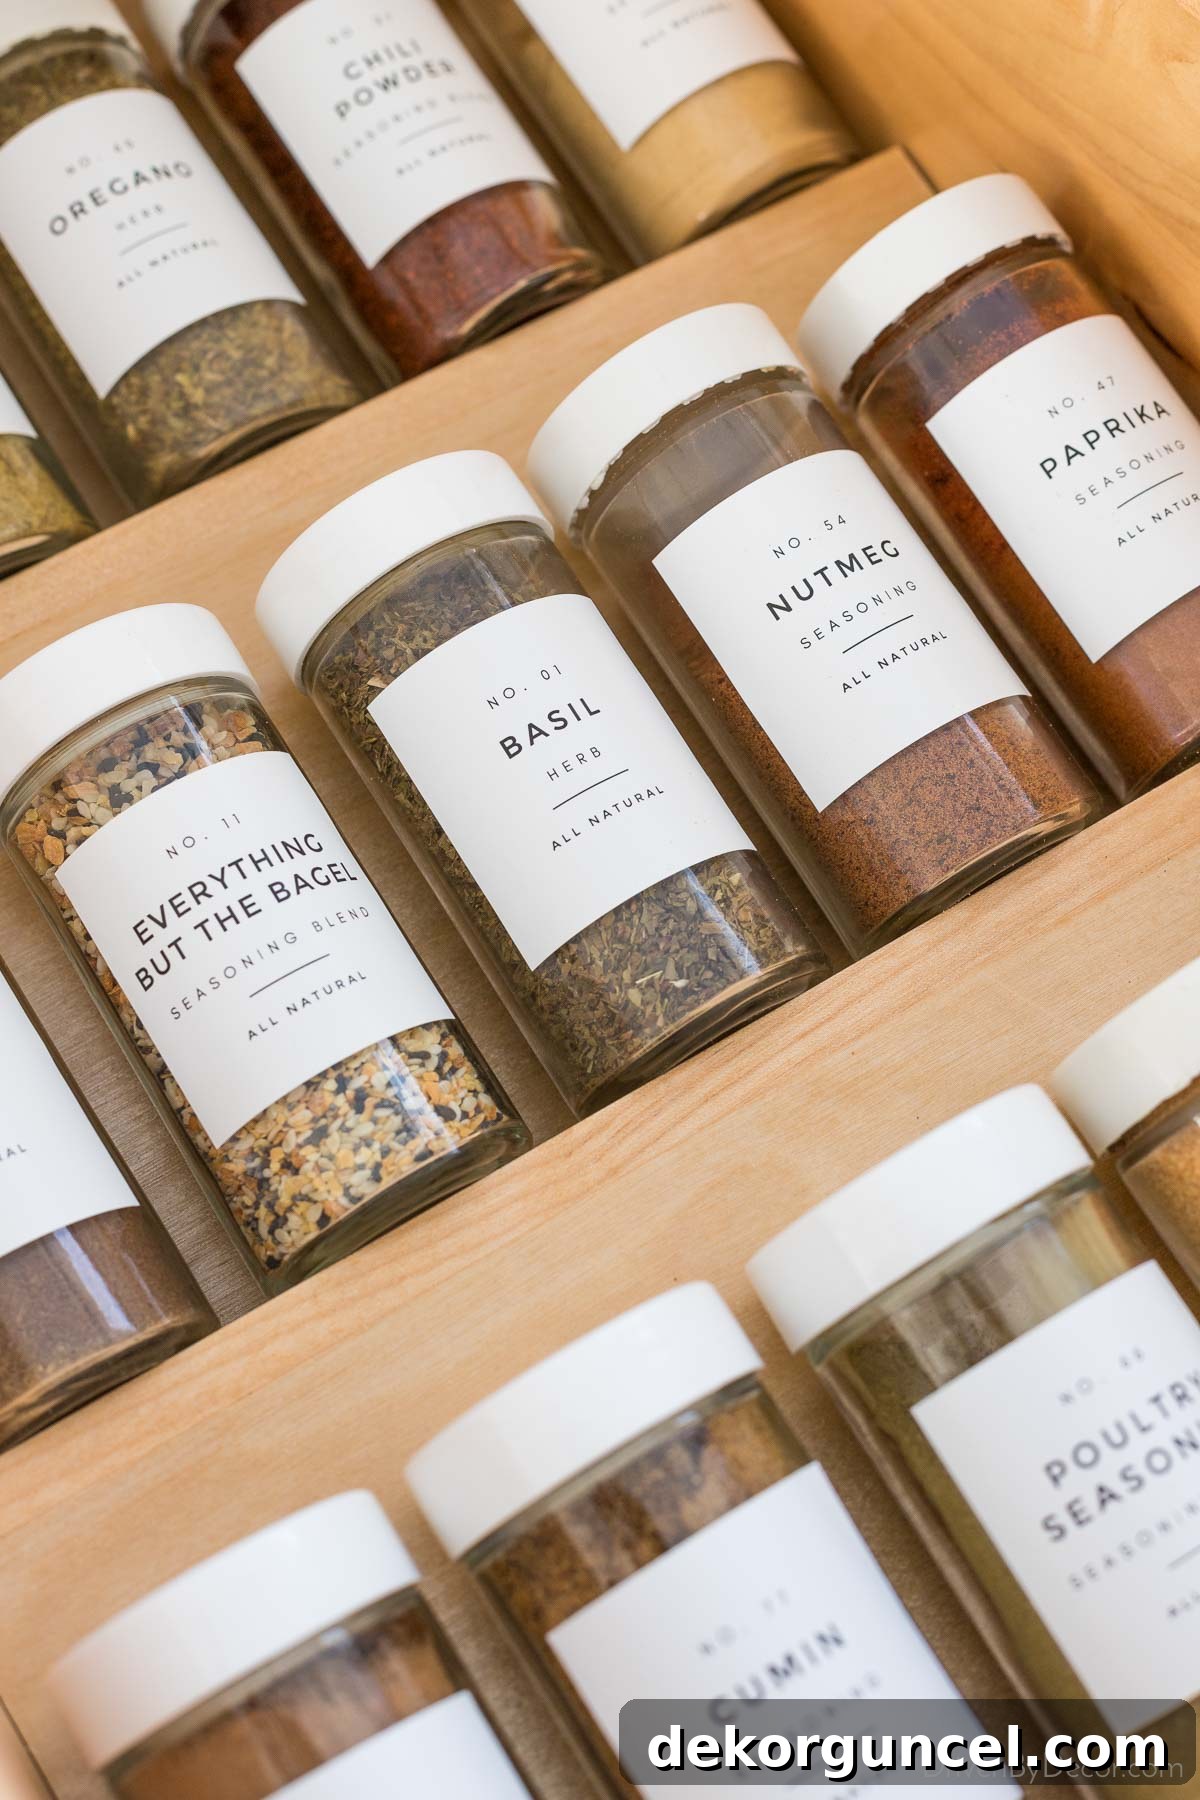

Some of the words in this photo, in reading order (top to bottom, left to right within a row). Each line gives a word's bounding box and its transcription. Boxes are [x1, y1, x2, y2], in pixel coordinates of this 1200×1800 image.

[334, 60, 454, 120] POWDER
[342, 40, 421, 80] CHILI
[49, 162, 192, 236] OREGANO
[1048, 397, 1084, 418] NO.
[1097, 376, 1114, 390] 47
[1039, 400, 1170, 480] PAPRIKA
[1075, 440, 1185, 505] SEASONING
[773, 538, 811, 558] NO.
[824, 515, 846, 530] 54
[1118, 525, 1144, 547] ALL
[766, 540, 899, 621] NUTMEG
[800, 581, 916, 649] SEASONING
[487, 688, 527, 709] NO.
[541, 665, 561, 680] 01
[843, 671, 871, 693] ALL
[877, 632, 947, 669] NATURAL
[499, 698, 600, 759] BASIL
[547, 747, 601, 781] HERB
[166, 836, 208, 859] NO.
[221, 814, 240, 828] 11
[553, 828, 581, 851] ALL
[588, 786, 664, 826] NATURAL
[133, 834, 323, 945] EVERYTHING
[135, 937, 186, 992] BUT
[193, 894, 262, 941] THE
[272, 861, 358, 903] BAGEL
[171, 932, 297, 1020] SEASONING
[312, 907, 369, 932] BLEND
[249, 1017, 278, 1040] ALL
[286, 972, 366, 1015] NATURAL
[0, 1144, 26, 1162] AL
[1041, 1422, 1200, 1542] SEASON
[708, 1621, 846, 1727] CUMIN
